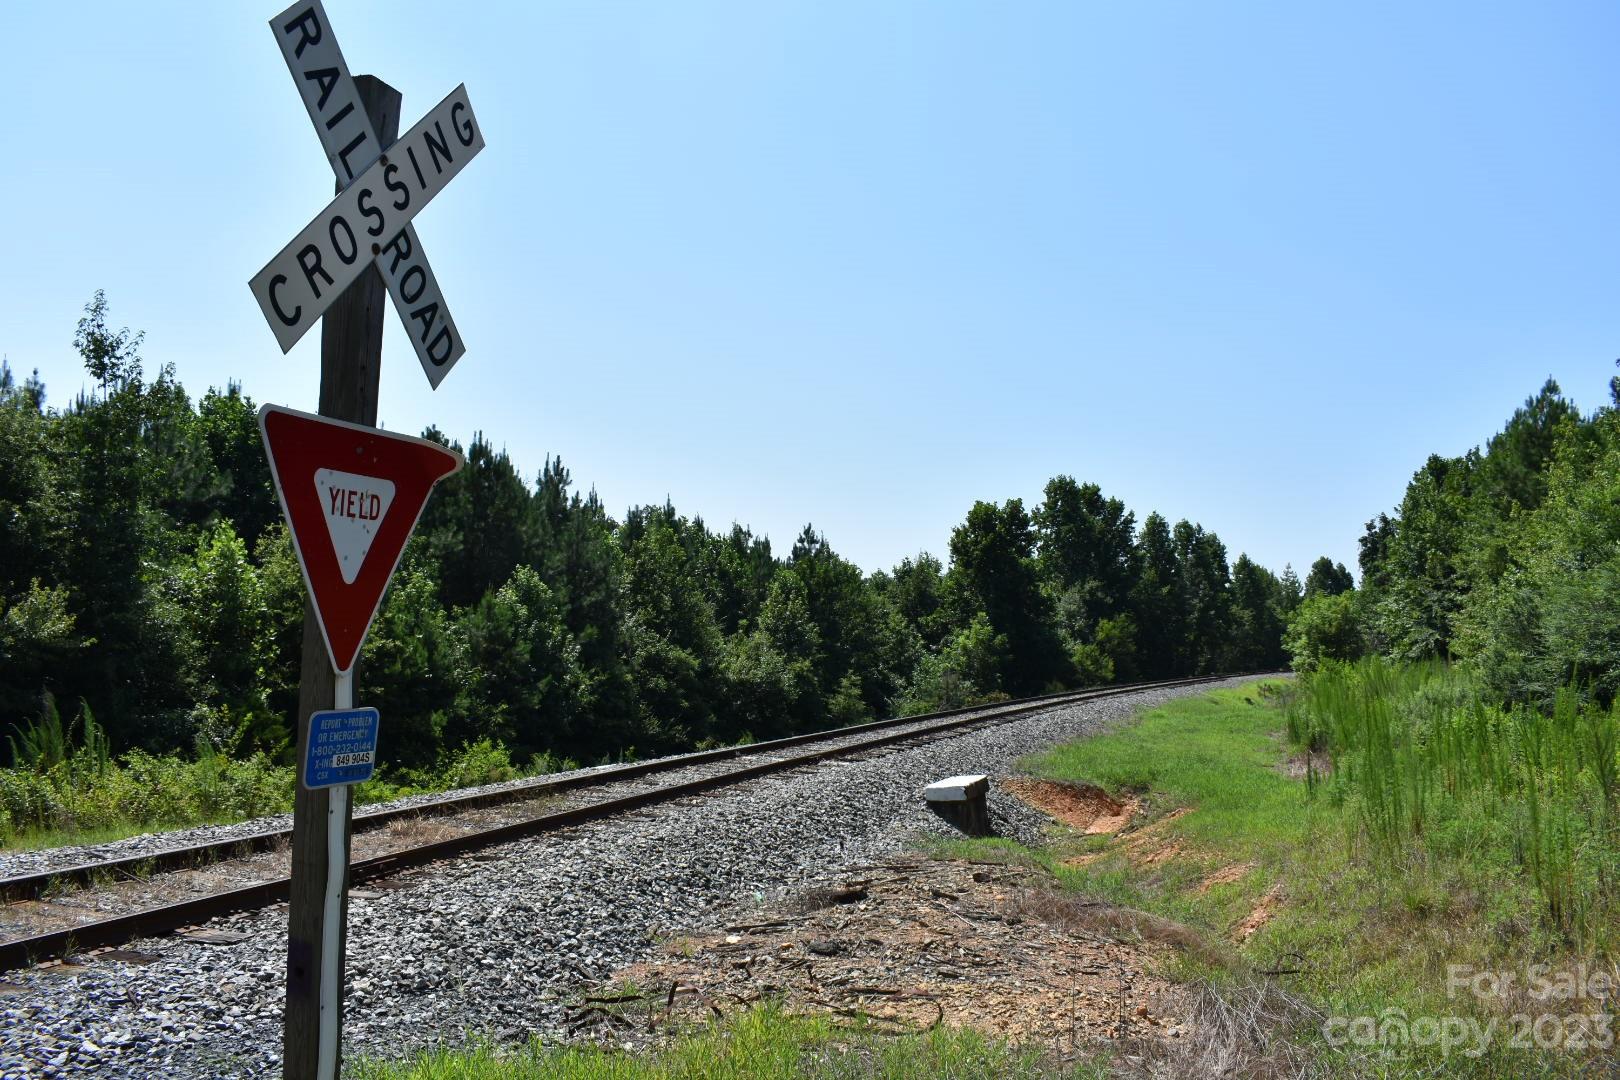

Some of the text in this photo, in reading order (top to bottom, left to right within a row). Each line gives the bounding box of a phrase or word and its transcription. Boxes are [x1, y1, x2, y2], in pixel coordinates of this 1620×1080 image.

[284, 6, 454, 367] RAIL ROAD
[268, 101, 475, 327] CROSSING
[329, 486, 381, 521] YIELD
[320, 719, 342, 730] REPORT
[347, 716, 372, 727] PROBLEM
[318, 730, 368, 743] OR EMERGENCY
[312, 742, 371, 756] 1-800-232-0144
[336, 754, 350, 766] 849
[352, 752, 370, 764] 904S
